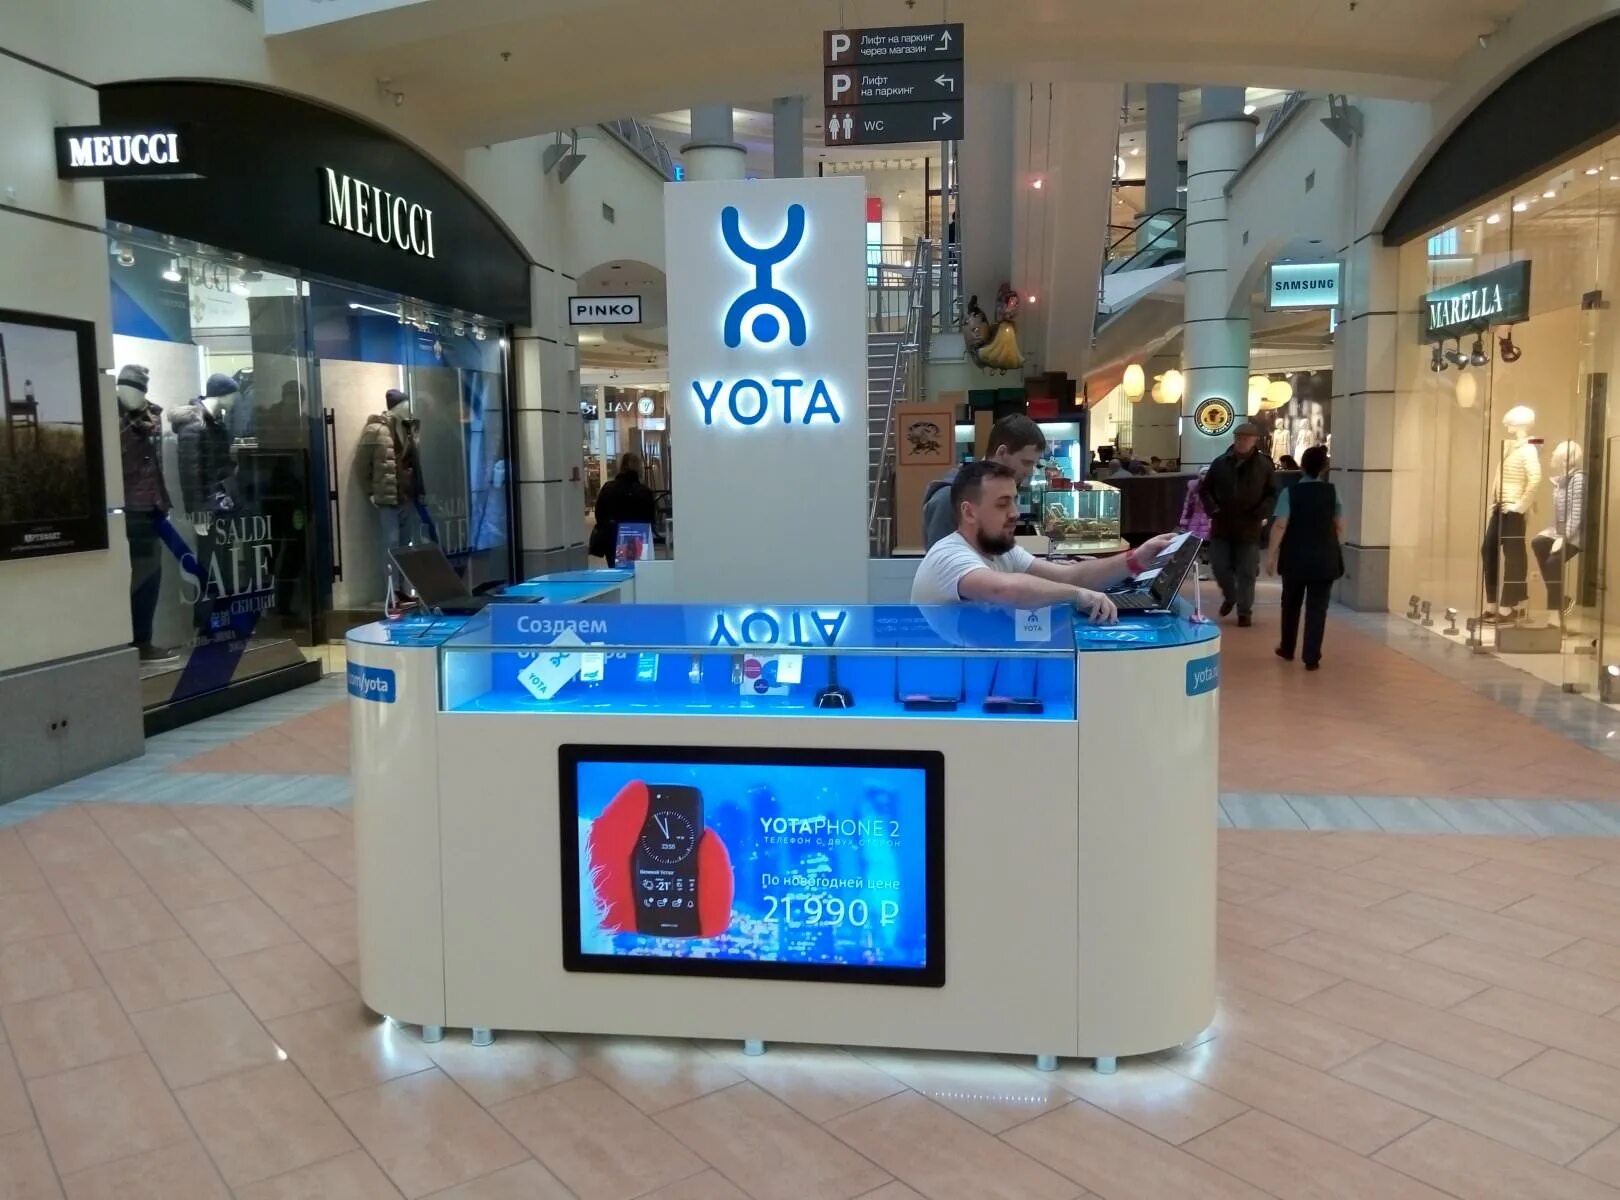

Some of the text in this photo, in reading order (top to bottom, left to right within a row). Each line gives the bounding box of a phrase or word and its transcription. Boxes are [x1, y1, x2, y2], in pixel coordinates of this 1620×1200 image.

[831, 34, 851, 61] P
[860, 35, 886, 45] Лифт
[901, 34, 935, 44] паркинг
[860, 45, 926, 57] через магазин
[832, 74, 851, 100] P
[861, 76, 888, 86] Лифт
[875, 87, 915, 97] паркинг
[864, 120, 884, 131] WC
[69, 133, 179, 167] MEUCCI
[326, 167, 435, 258] MEUCCI
[1275, 279, 1334, 291] SAMSUNG
[577, 304, 633, 316] PINKO
[1429, 283, 1503, 330] MARELLA
[692, 378, 841, 426] YOTA
[216, 514, 272, 545] SALDI
[180, 543, 275, 605] SALE
[517, 615, 608, 635] Создаем
[528, 672, 548, 694] YOTA
[760, 817, 900, 837] YOTAPHONE 2
[763, 836, 811, 845] ТЕЛЕФОН
[827, 838, 854, 848] ДВУХ
[762, 873, 900, 889] По новогодней цене
